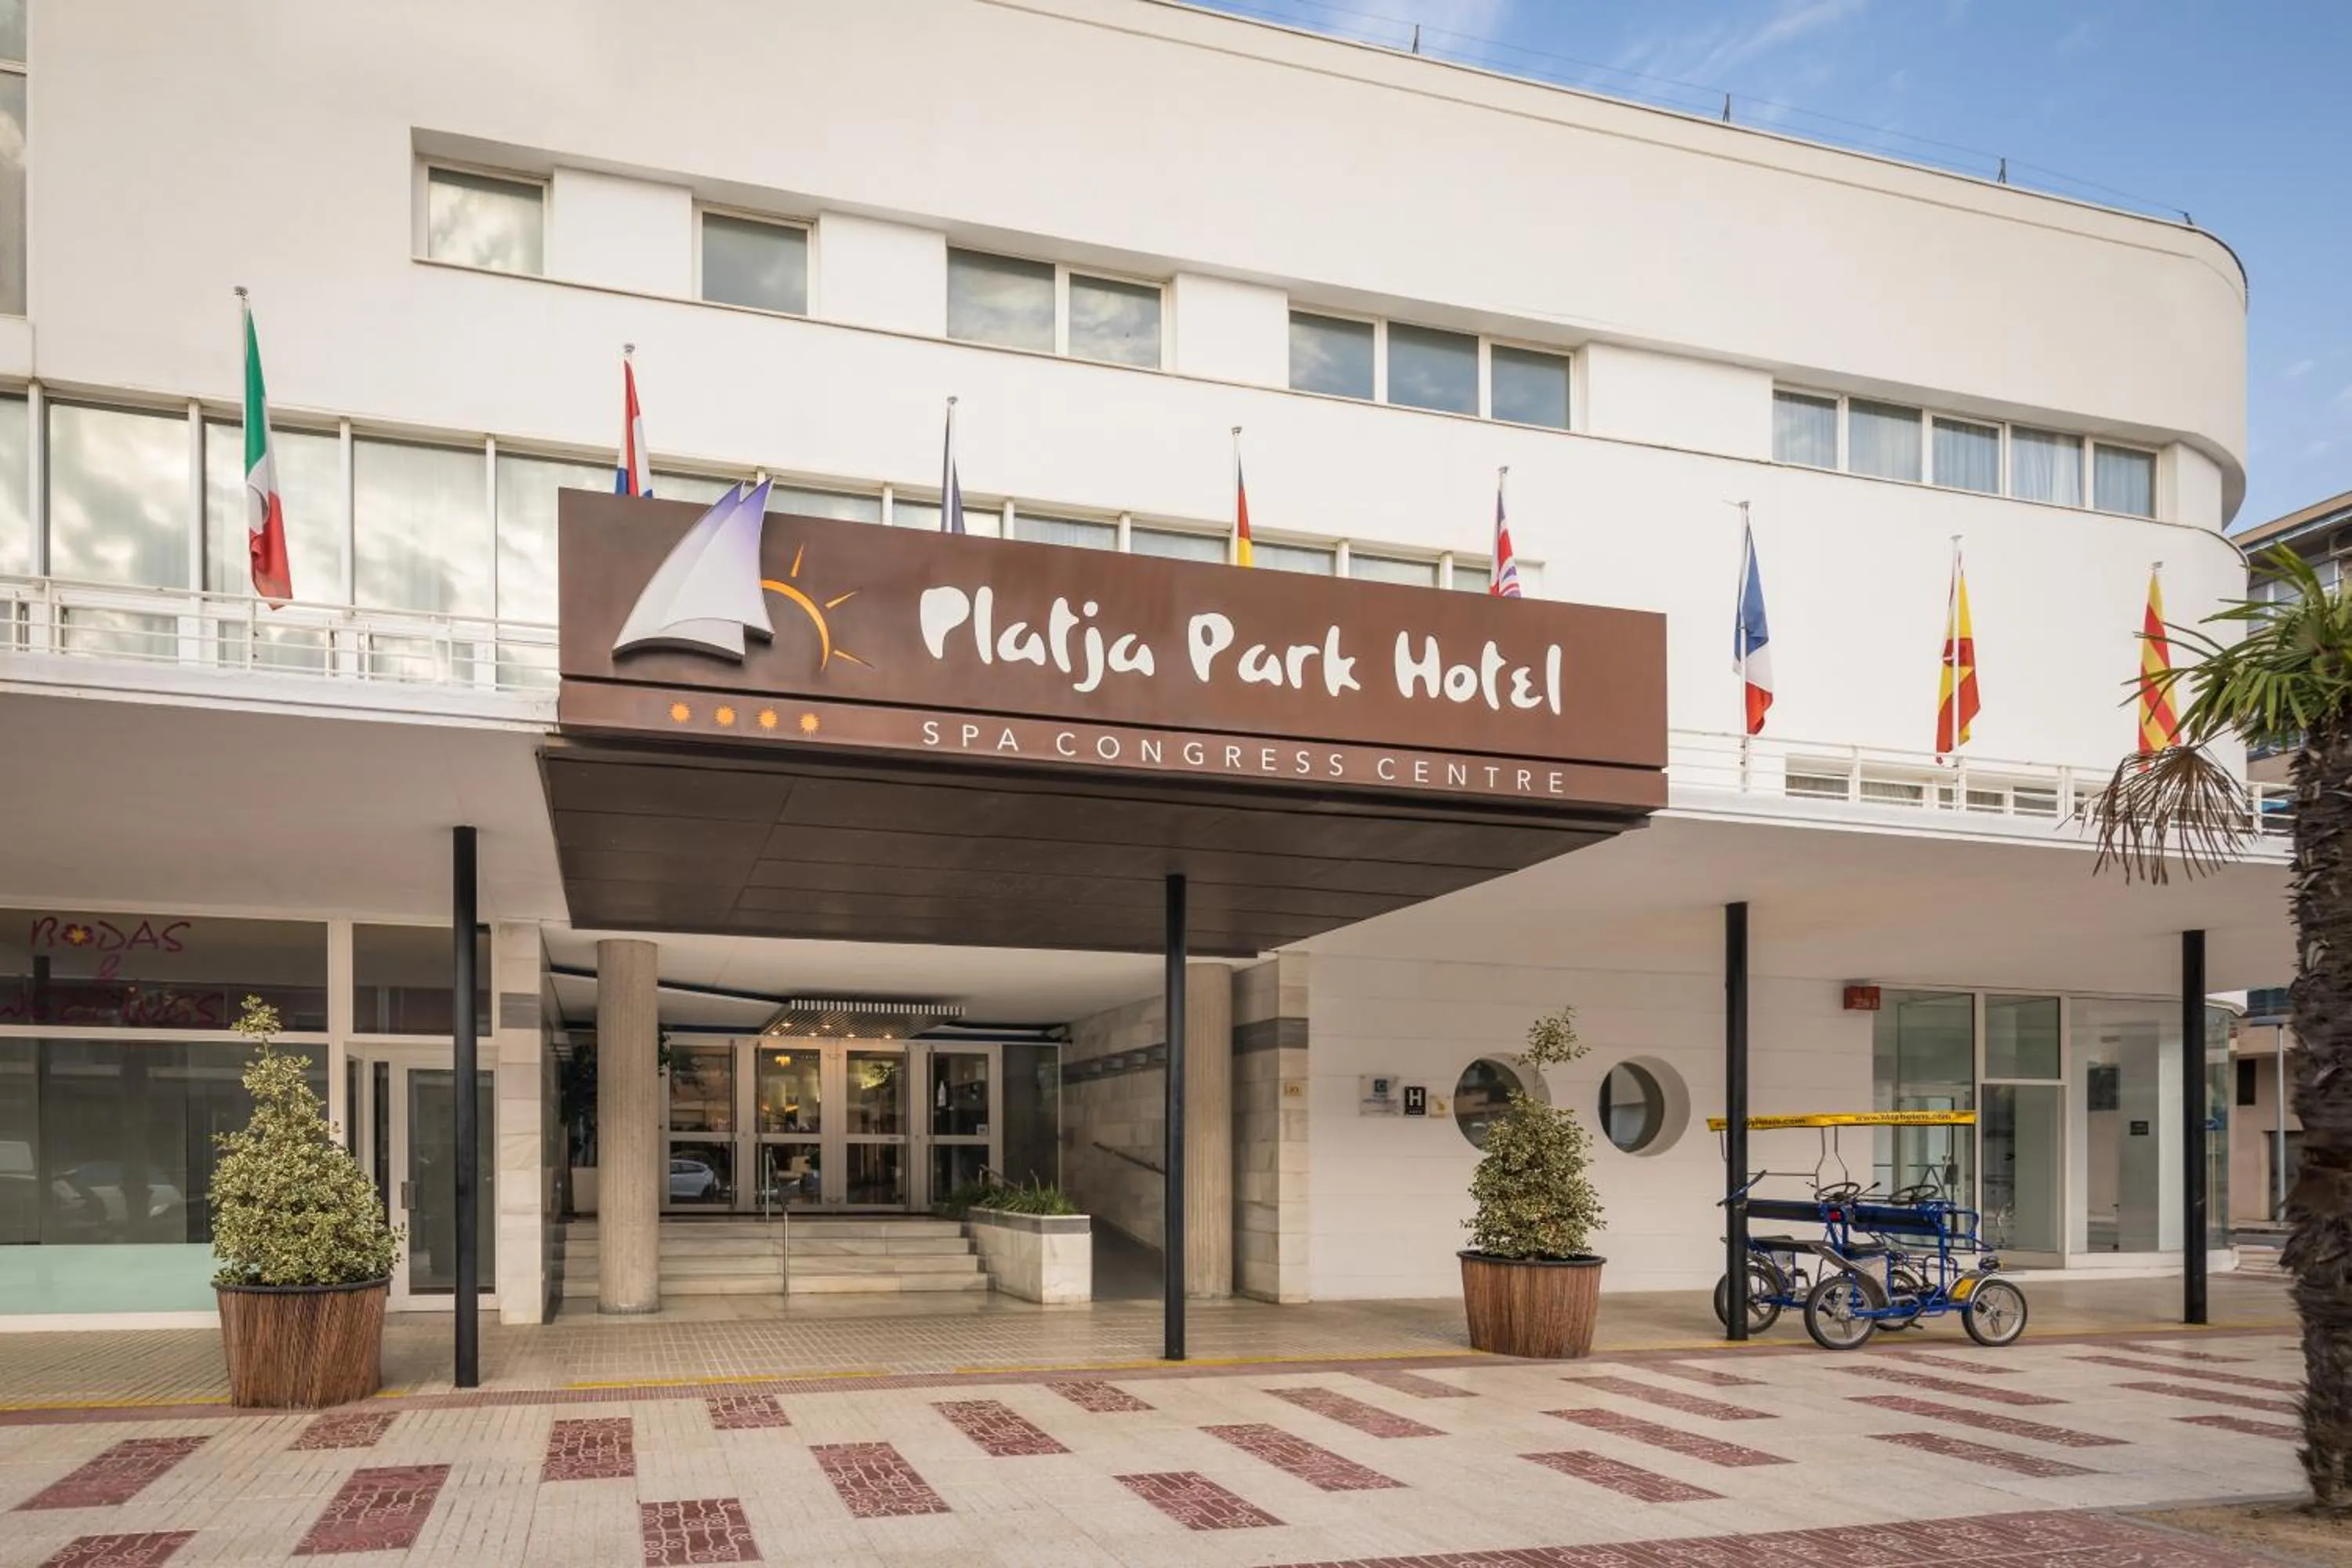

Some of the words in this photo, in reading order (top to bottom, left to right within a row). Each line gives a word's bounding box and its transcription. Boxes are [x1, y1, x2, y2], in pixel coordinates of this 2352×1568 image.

[920, 586, 1155, 692] Platja
[1188, 612, 1361, 697] Park
[1395, 630, 1562, 715] Hotel
[923, 720, 1019, 752] SPA
[1056, 731, 1344, 776] CONGRESS
[1377, 757, 1565, 793] CENTRE
[1408, 1089, 1422, 1106] H
